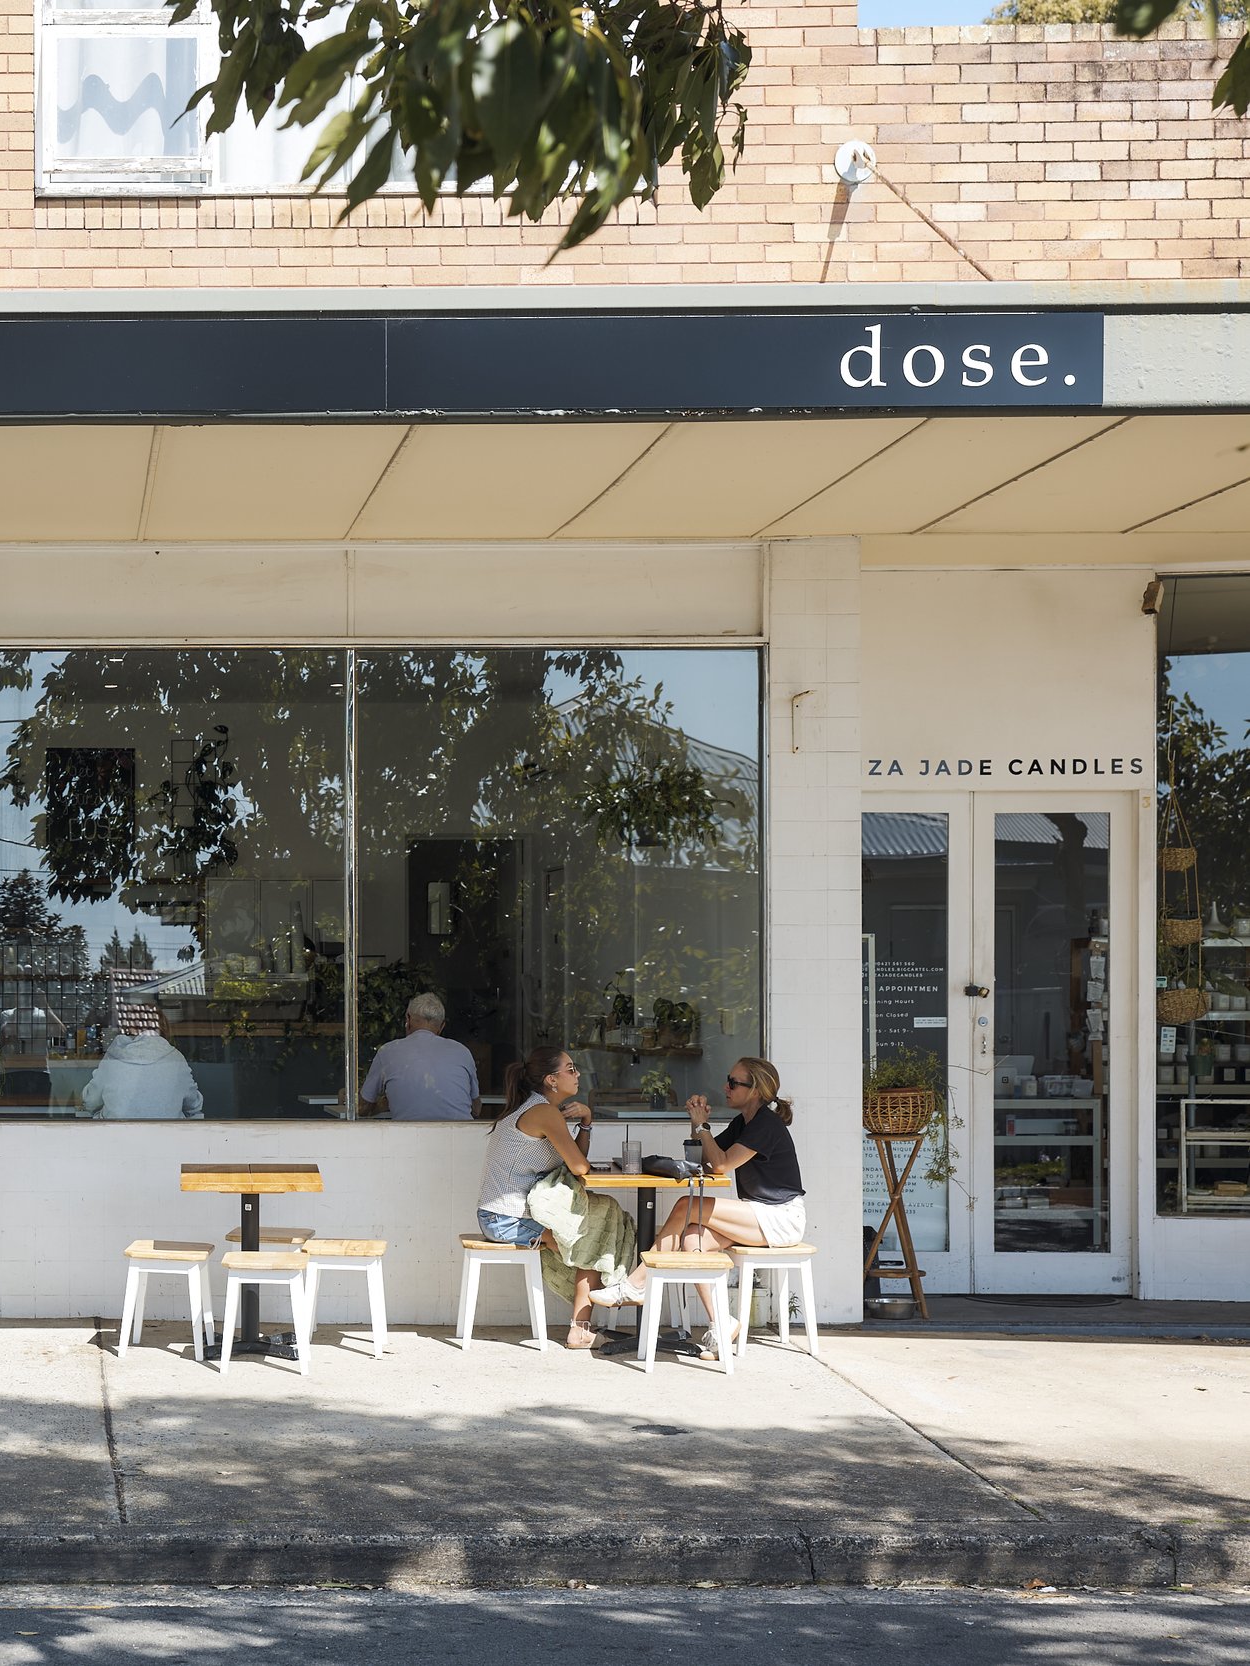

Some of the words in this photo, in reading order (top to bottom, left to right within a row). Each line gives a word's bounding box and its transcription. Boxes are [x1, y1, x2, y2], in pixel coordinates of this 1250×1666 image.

[839, 323, 1077, 388] dose.
[919, 759, 992, 776] JADE
[1008, 757, 1144, 775] CANDLES
